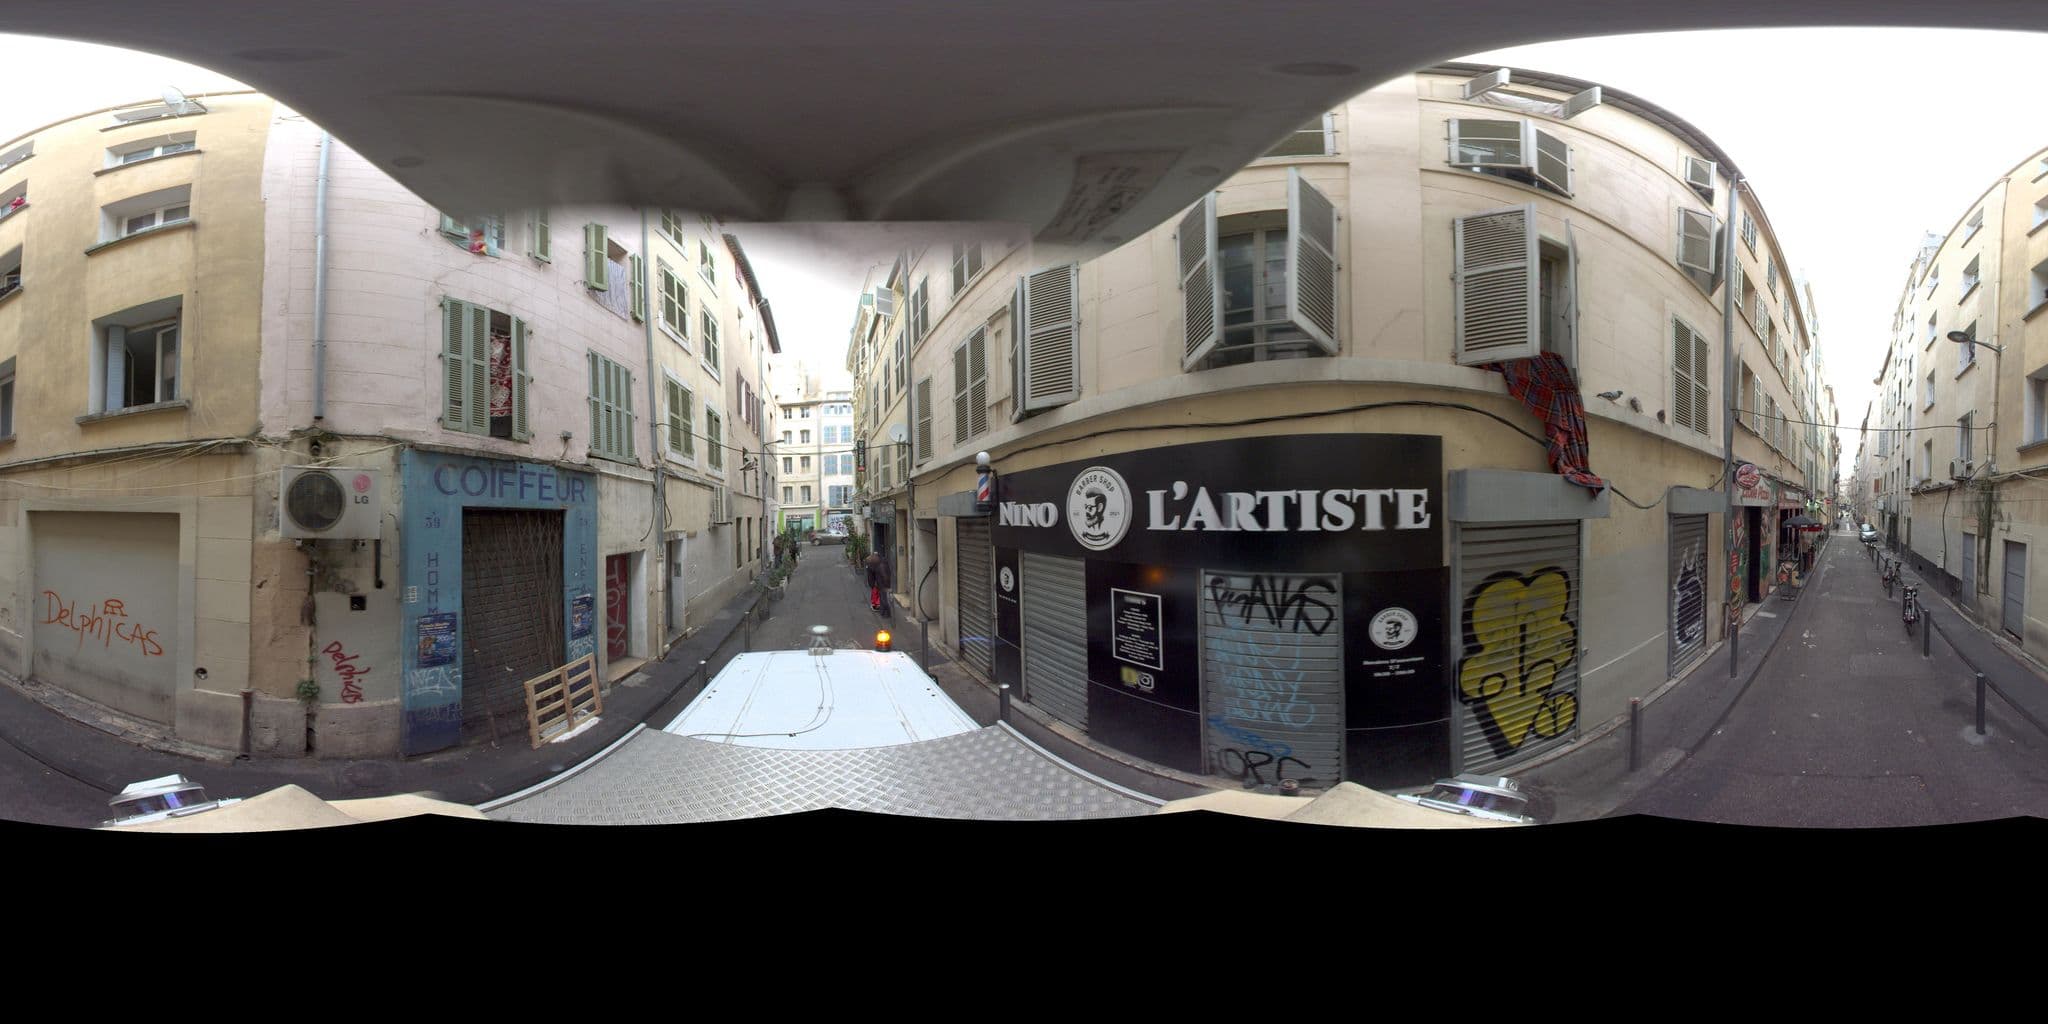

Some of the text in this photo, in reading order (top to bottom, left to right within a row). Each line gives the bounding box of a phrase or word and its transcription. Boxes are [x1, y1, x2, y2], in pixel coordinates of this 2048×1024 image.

[433, 463, 586, 503] COIFFEUR
[1099, 475, 1115, 493] SHOP
[354, 495, 369, 505] LG
[1146, 480, 1431, 532] L'ARTISTE
